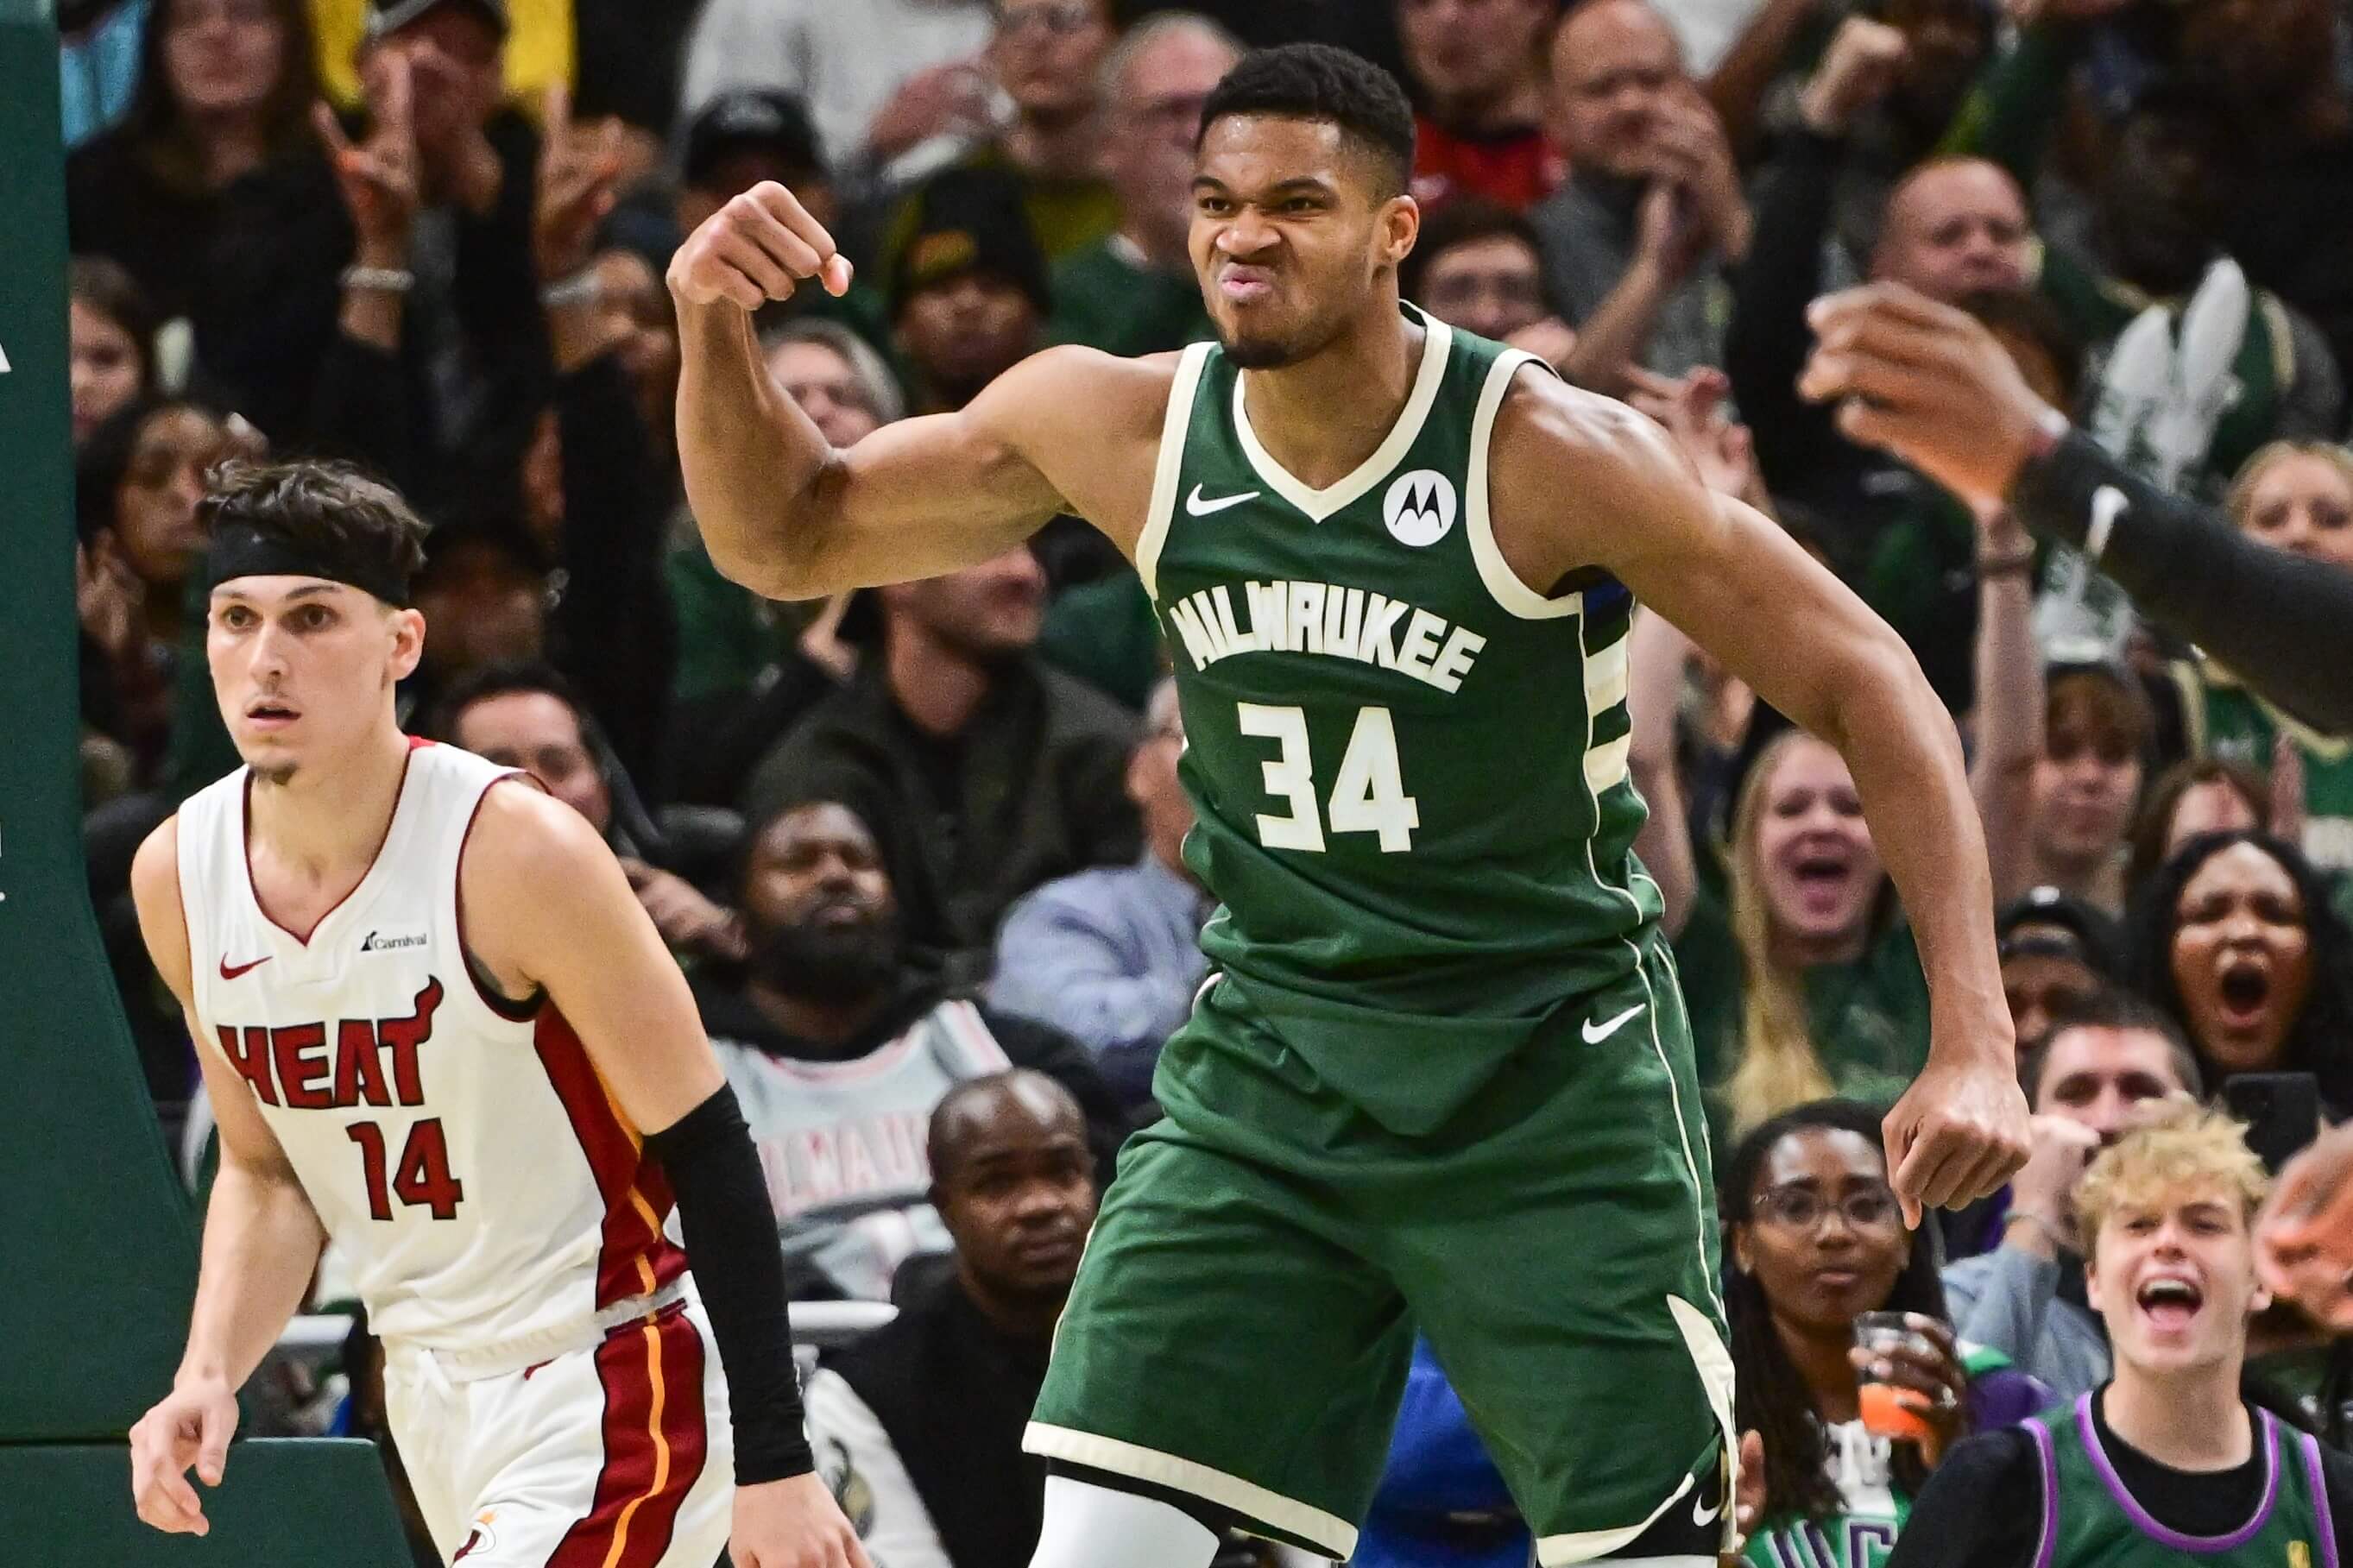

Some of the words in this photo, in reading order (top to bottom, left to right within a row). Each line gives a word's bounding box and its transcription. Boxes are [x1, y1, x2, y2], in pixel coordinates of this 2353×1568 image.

[1169, 580, 1487, 694] MILWAUKEE
[1237, 702, 1420, 853] 34
[374, 933, 427, 950] Carnival
[216, 973, 445, 1110] HEAT
[345, 1117, 464, 1221] 14
